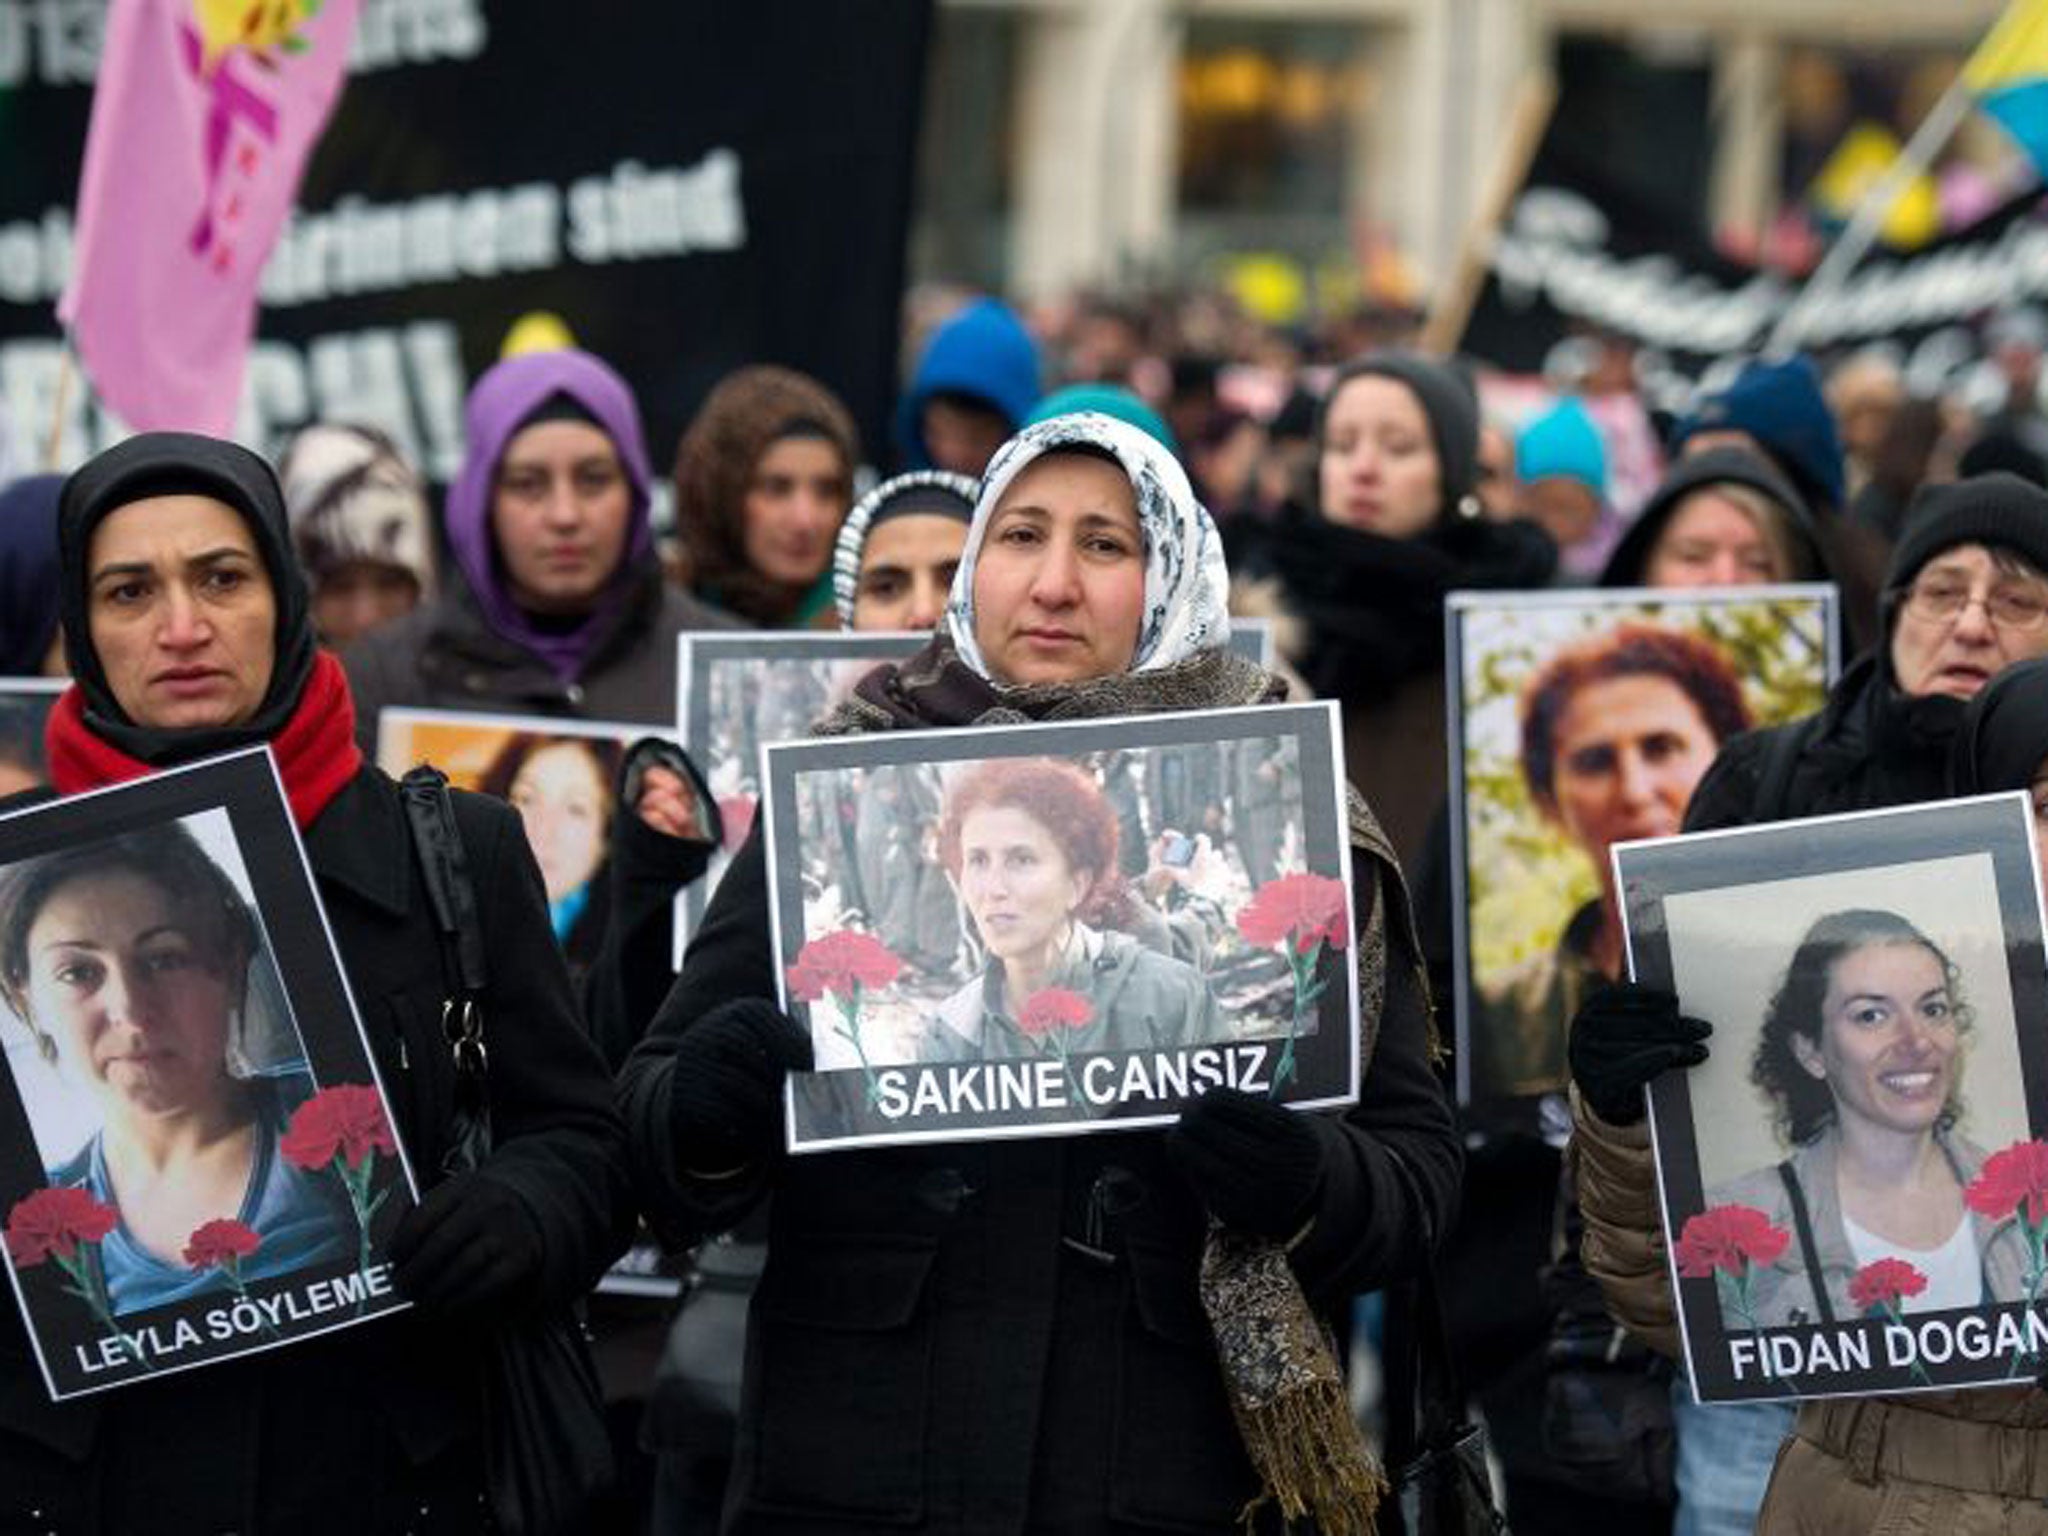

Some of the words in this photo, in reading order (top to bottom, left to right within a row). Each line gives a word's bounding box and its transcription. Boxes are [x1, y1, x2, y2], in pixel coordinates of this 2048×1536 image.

[877, 1061, 1067, 1118] SAKINE
[1083, 1046, 1270, 1106] CANSIZ
[76, 1319, 202, 1373] LEYLA
[206, 1262, 395, 1341] SÖYLEME
[1729, 1328, 1872, 1381] FIDAN
[1884, 1308, 2048, 1369] DOGAN
